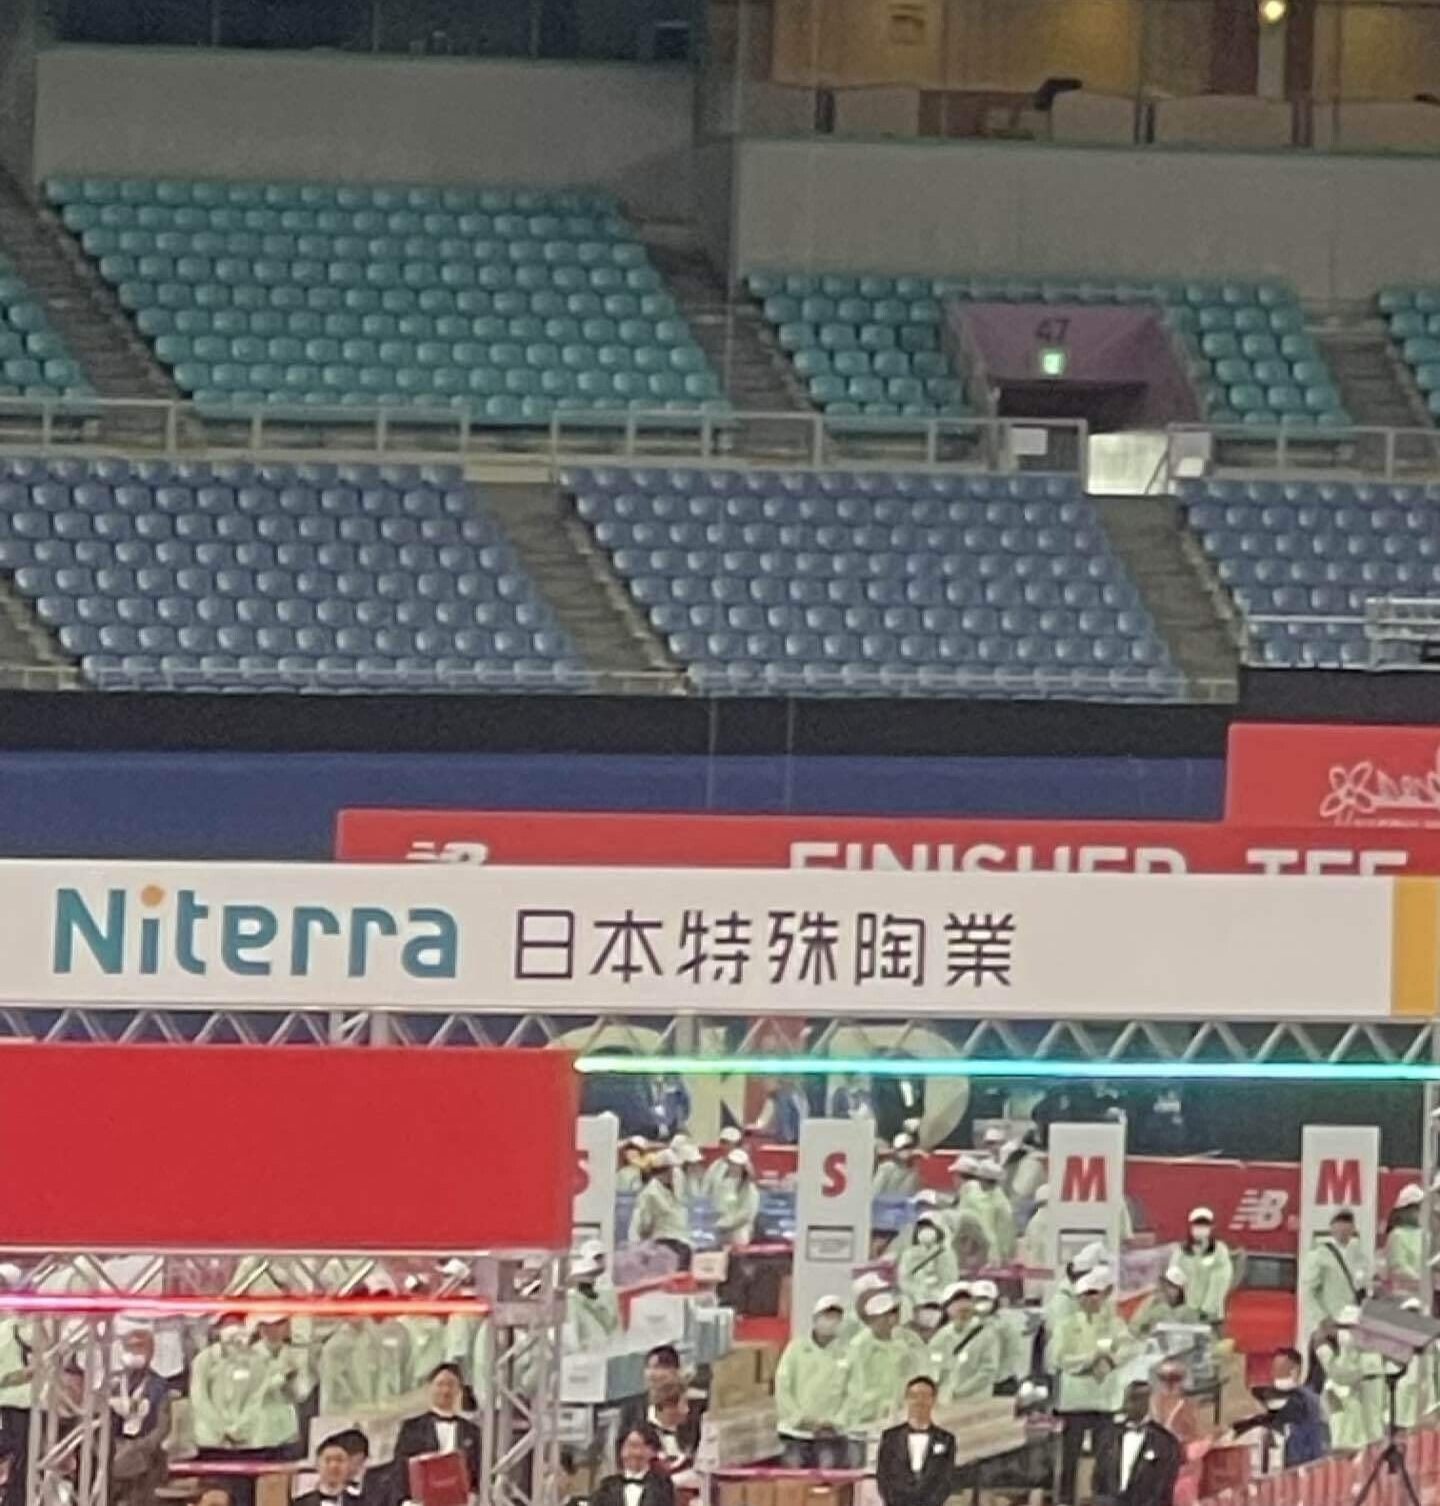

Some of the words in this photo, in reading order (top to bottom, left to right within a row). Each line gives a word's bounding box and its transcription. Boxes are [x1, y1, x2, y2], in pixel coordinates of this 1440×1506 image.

[53, 884, 458, 979] Niterra
[514, 907, 1017, 988] 日本特殊陶業
[821, 1153, 847, 1196] S
[1061, 1156, 1107, 1203] M
[1315, 1159, 1362, 1205] M
